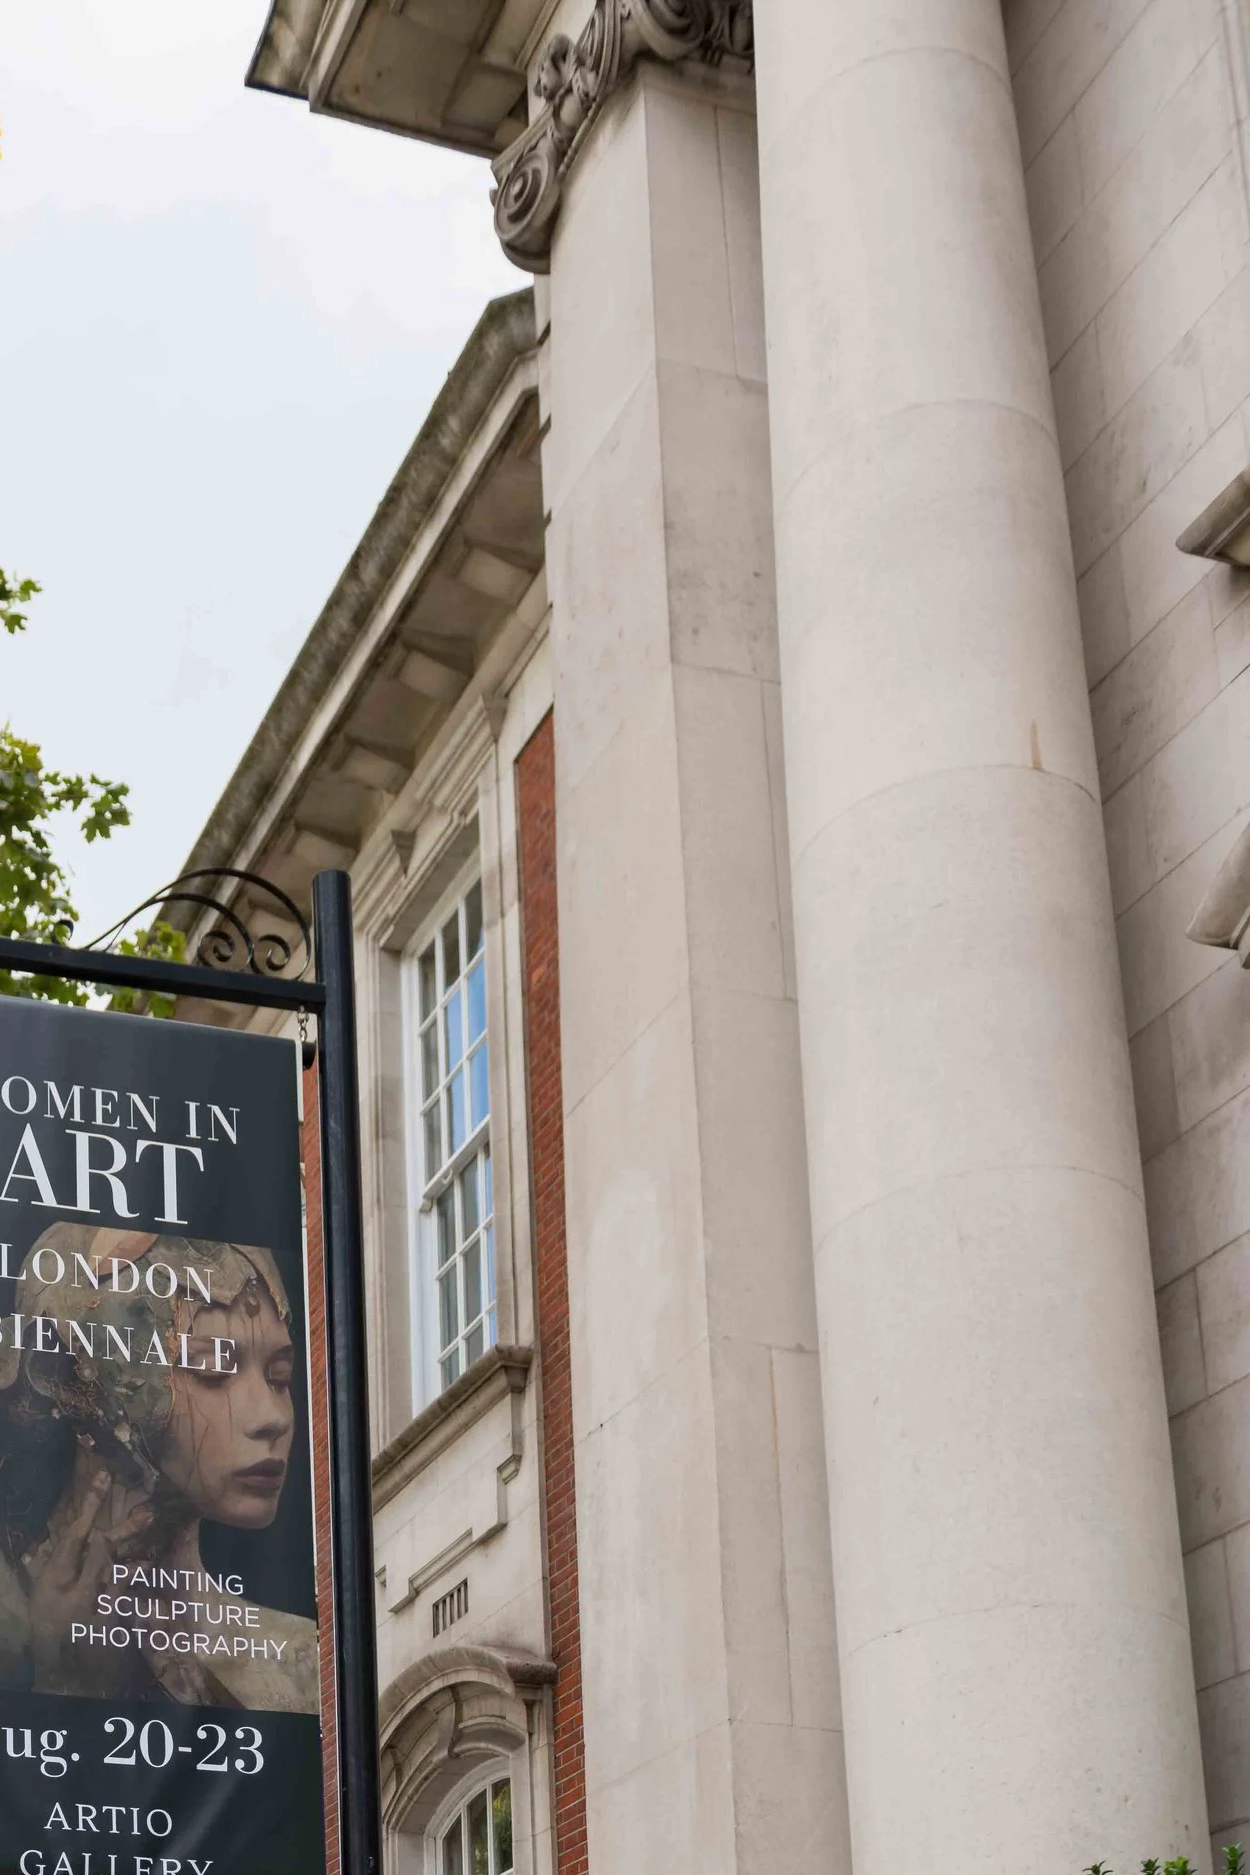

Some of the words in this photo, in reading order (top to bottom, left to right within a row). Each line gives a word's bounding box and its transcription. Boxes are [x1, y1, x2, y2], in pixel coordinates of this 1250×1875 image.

[185, 1100, 240, 1144] IN
[112, 1564, 245, 1595] PAINTING
[96, 1594, 261, 1628] SCULPTURE
[70, 1623, 288, 1660] PHOTOGRAPHY
[102, 1716, 265, 1775] 20-23
[44, 1802, 173, 1837] ARTIO
